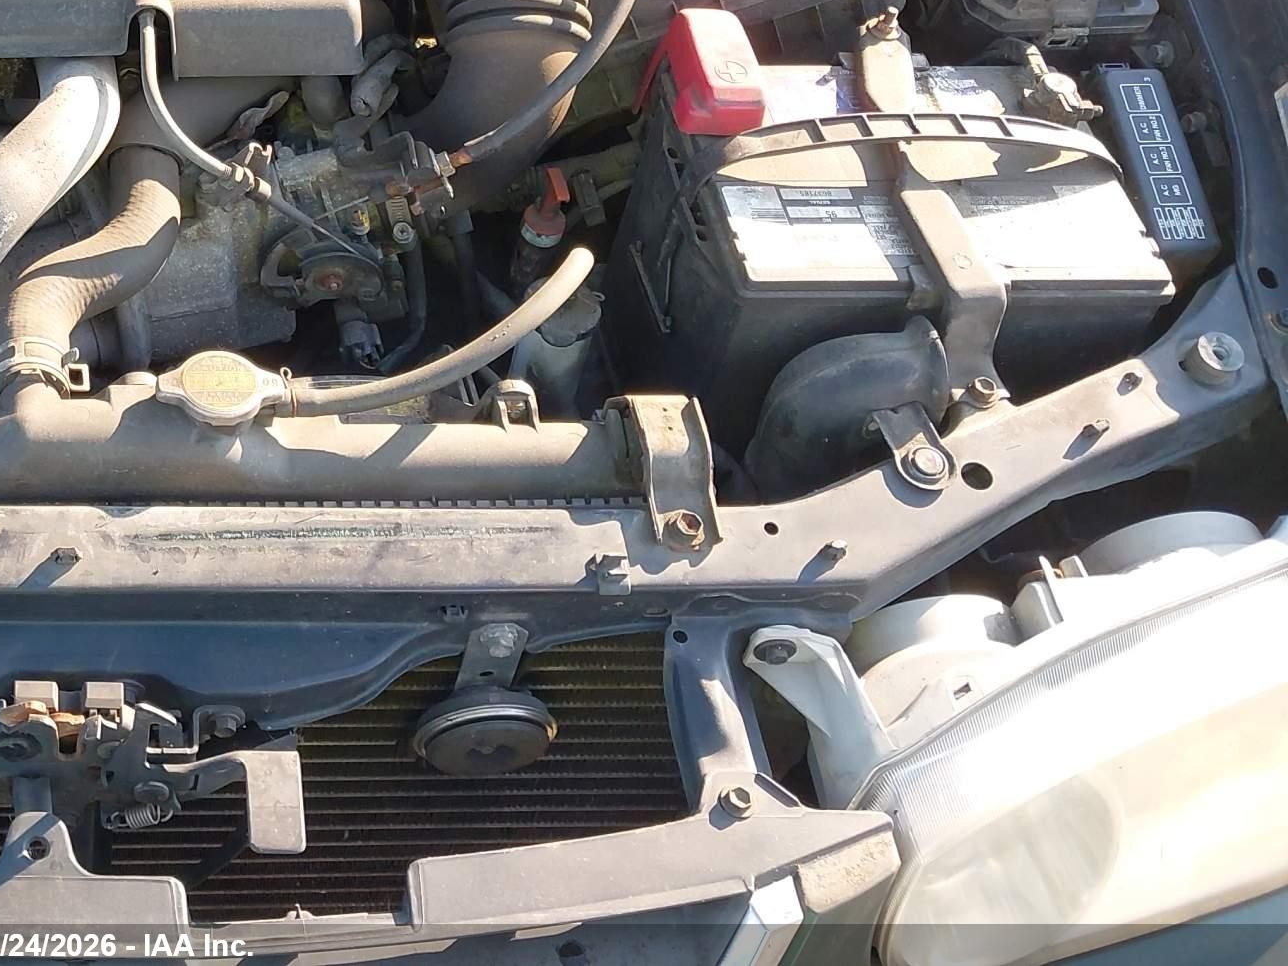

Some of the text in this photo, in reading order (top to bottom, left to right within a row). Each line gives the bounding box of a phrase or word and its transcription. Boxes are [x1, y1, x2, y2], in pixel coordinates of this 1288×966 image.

[1133, 86, 1146, 110] DIMMER
[1153, 127, 1163, 141] FAN
[1162, 159, 1173, 172] FAN
[1172, 184, 1181, 196] MG
